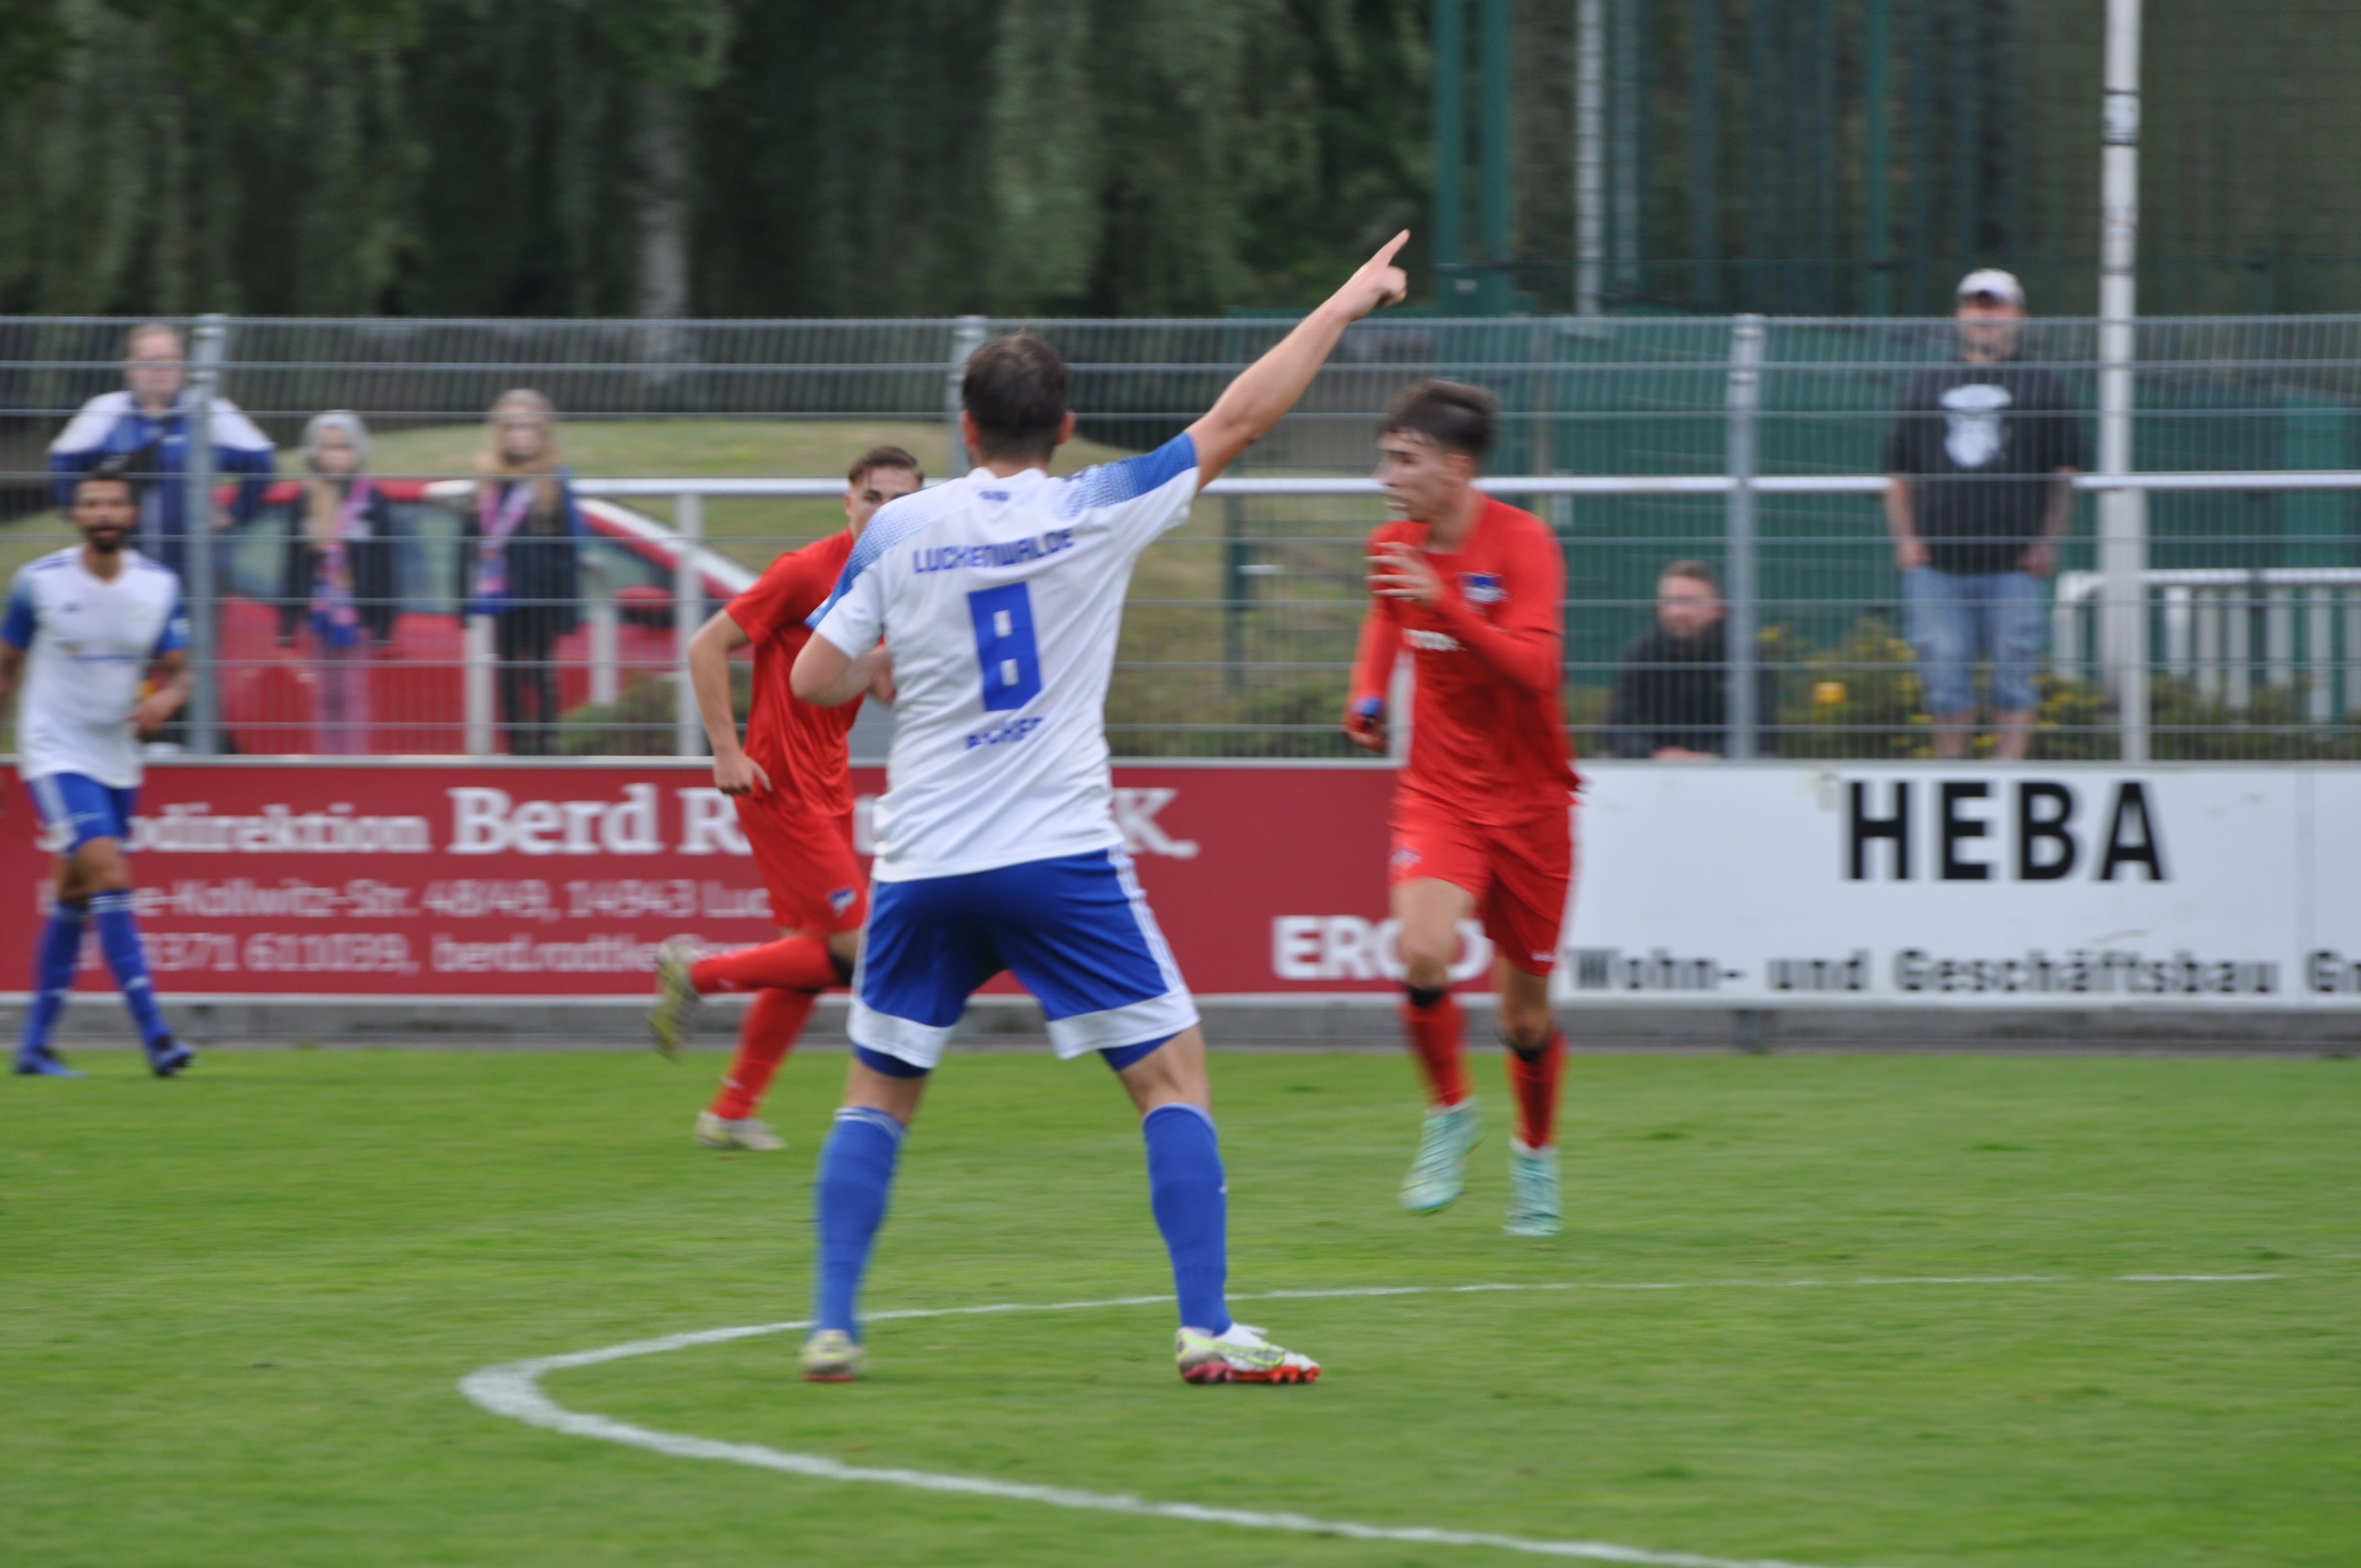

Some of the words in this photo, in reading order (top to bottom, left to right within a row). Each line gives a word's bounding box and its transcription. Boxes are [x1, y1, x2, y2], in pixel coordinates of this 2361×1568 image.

[913, 529, 1076, 574] LUCKENWALDE
[967, 580, 1043, 712] 8
[36, 802, 432, 853] direktion
[446, 782, 663, 856] Berd
[1845, 780, 2173, 882] HEBA
[36, 879, 420, 917] e-Kollwitz-Str.
[135, 933, 238, 971] 3371
[1566, 949, 1747, 990] Wohn-
[1766, 949, 1871, 990] und
[1891, 948, 2281, 993] Geschäftsbau
